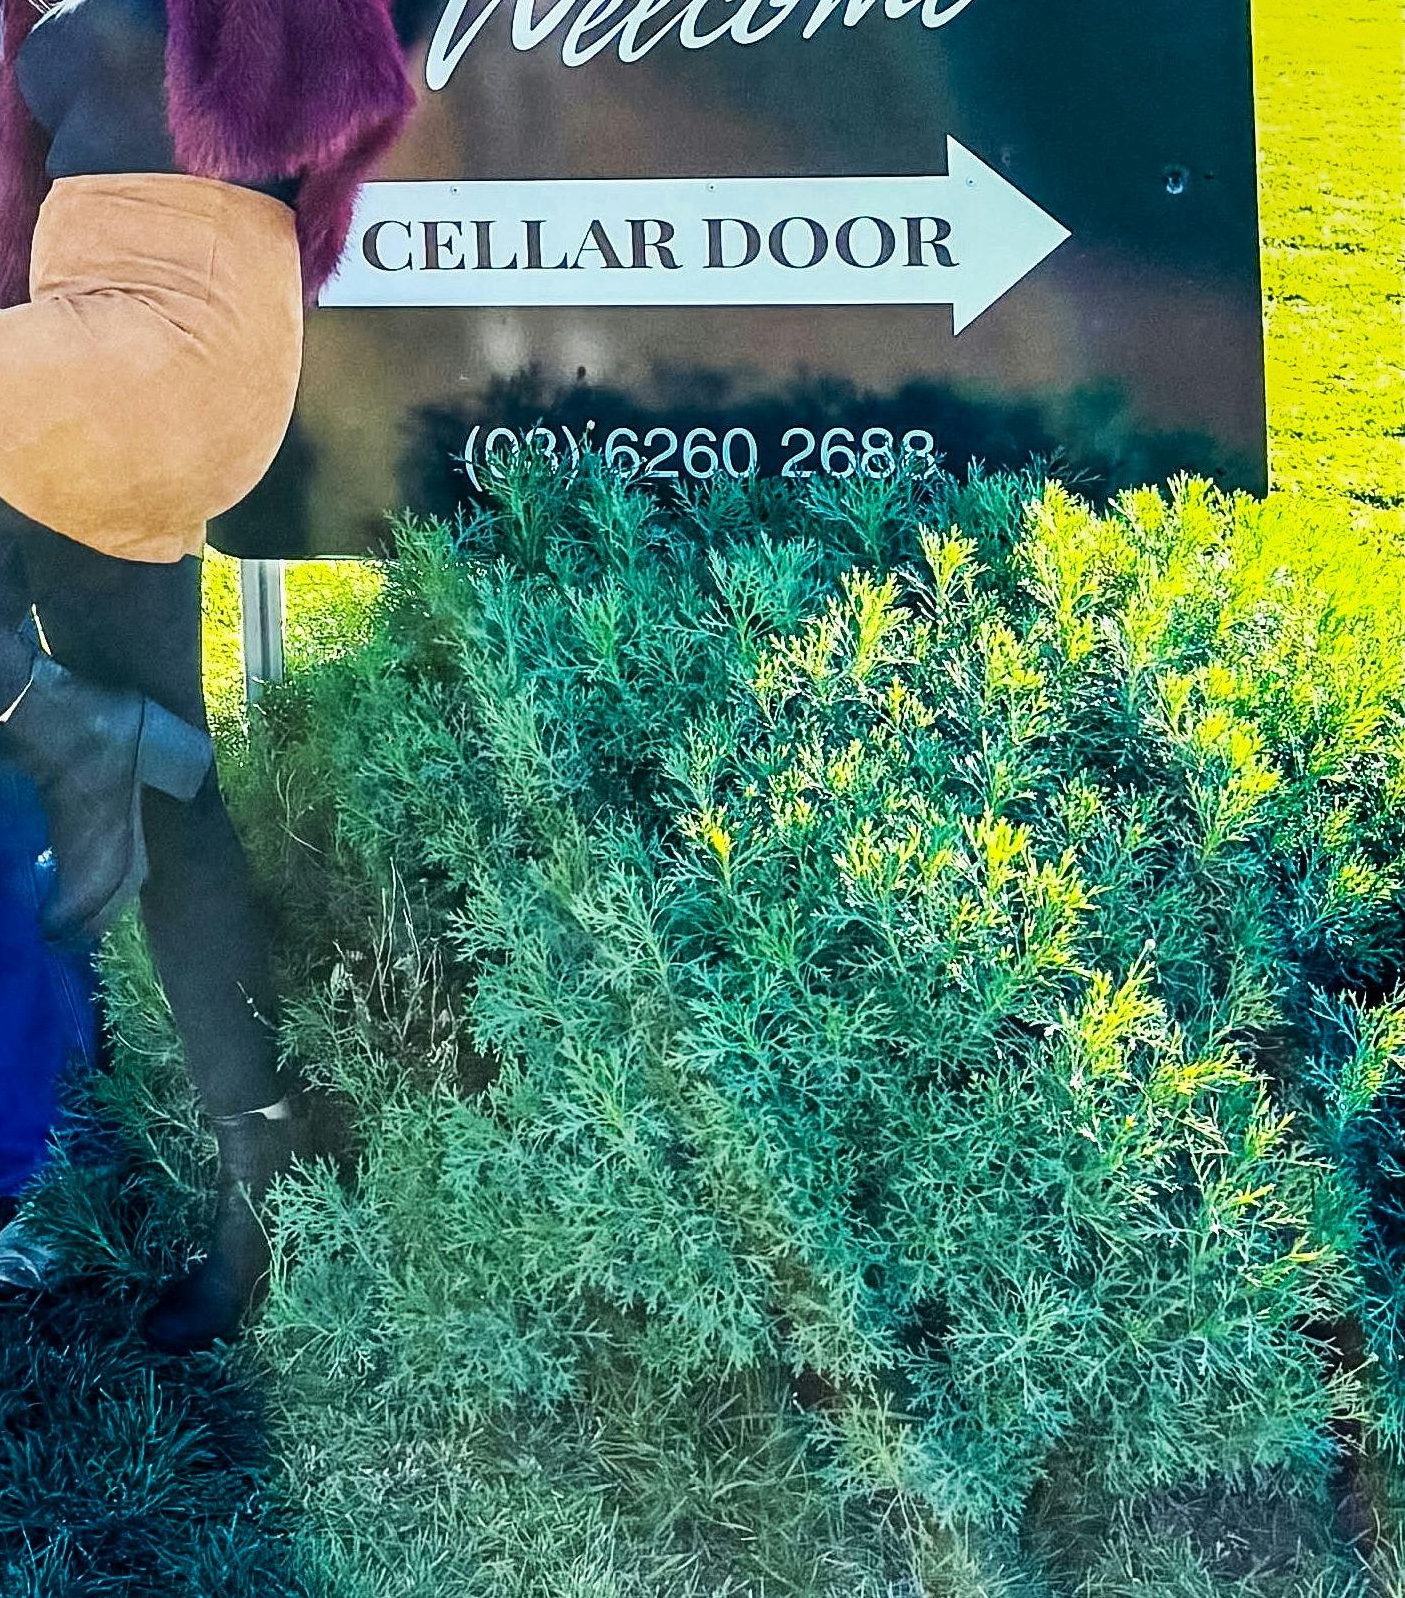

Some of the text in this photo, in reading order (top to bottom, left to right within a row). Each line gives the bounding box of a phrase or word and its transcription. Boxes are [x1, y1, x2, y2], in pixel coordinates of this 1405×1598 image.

[361, 215, 960, 272] CELLAR DOOR
[605, 427, 759, 479] 6260
[781, 427, 936, 480] 2688
